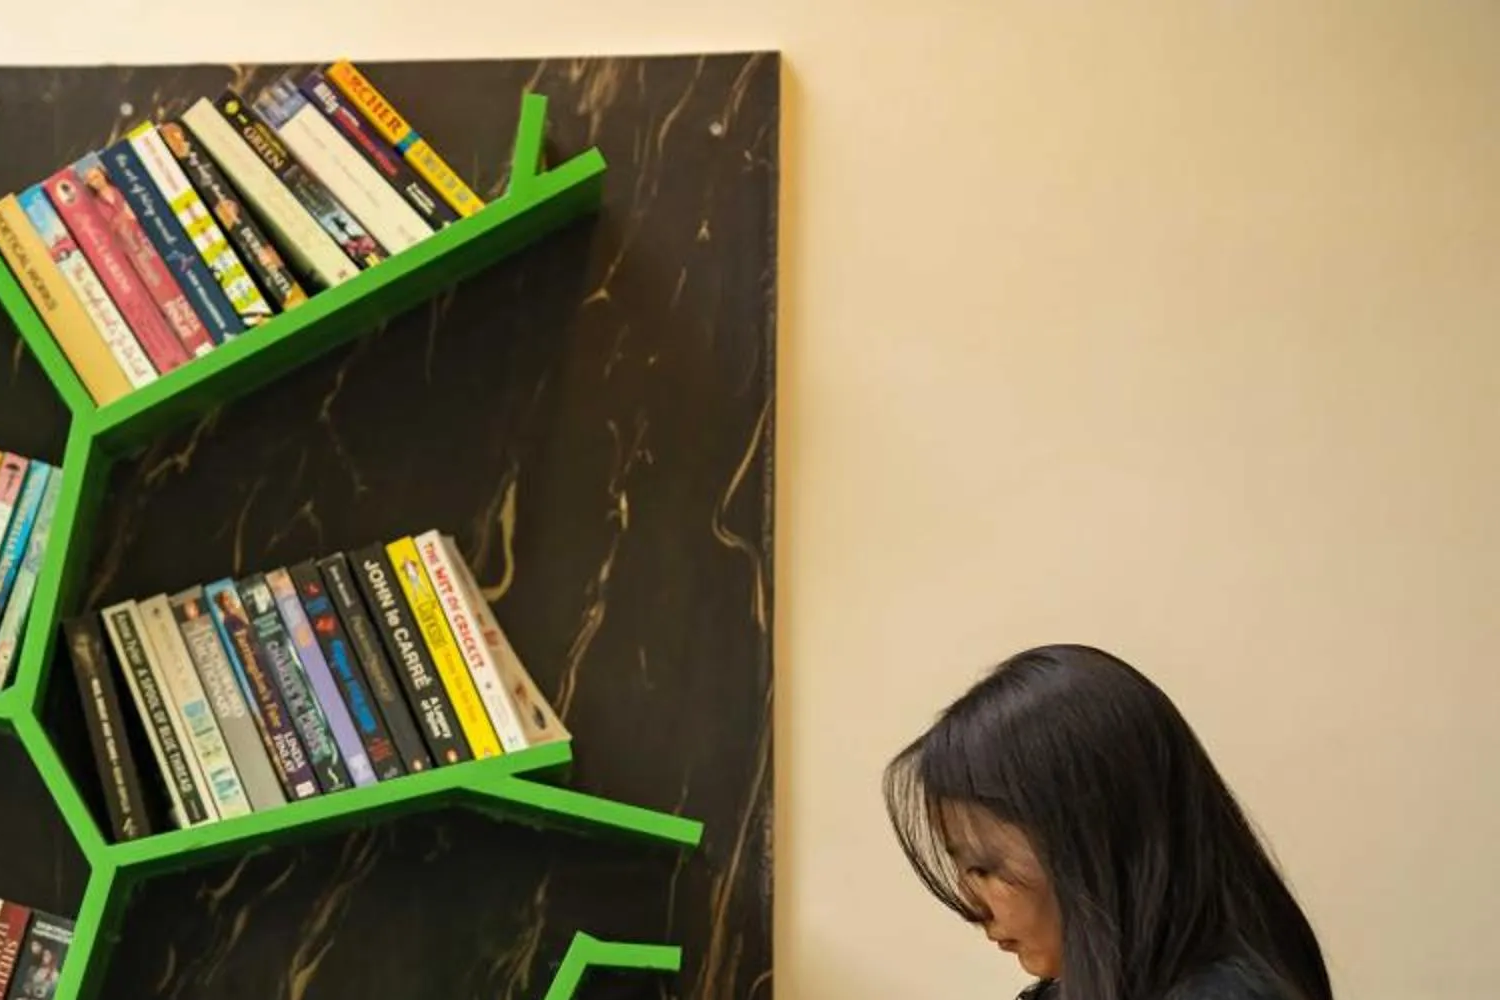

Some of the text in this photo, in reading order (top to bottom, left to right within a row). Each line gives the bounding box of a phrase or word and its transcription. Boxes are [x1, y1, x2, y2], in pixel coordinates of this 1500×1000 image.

[24, 266, 60, 313] WORKS
[362, 555, 397, 609] JOHN
[423, 540, 443, 565] THE
[433, 565, 455, 595] WIT
[451, 611, 487, 670] CRICKET
[384, 606, 405, 628] le
[391, 623, 435, 692] CARRÉ
[158, 724, 179, 754] BLUE
[169, 751, 194, 794] THREAD
